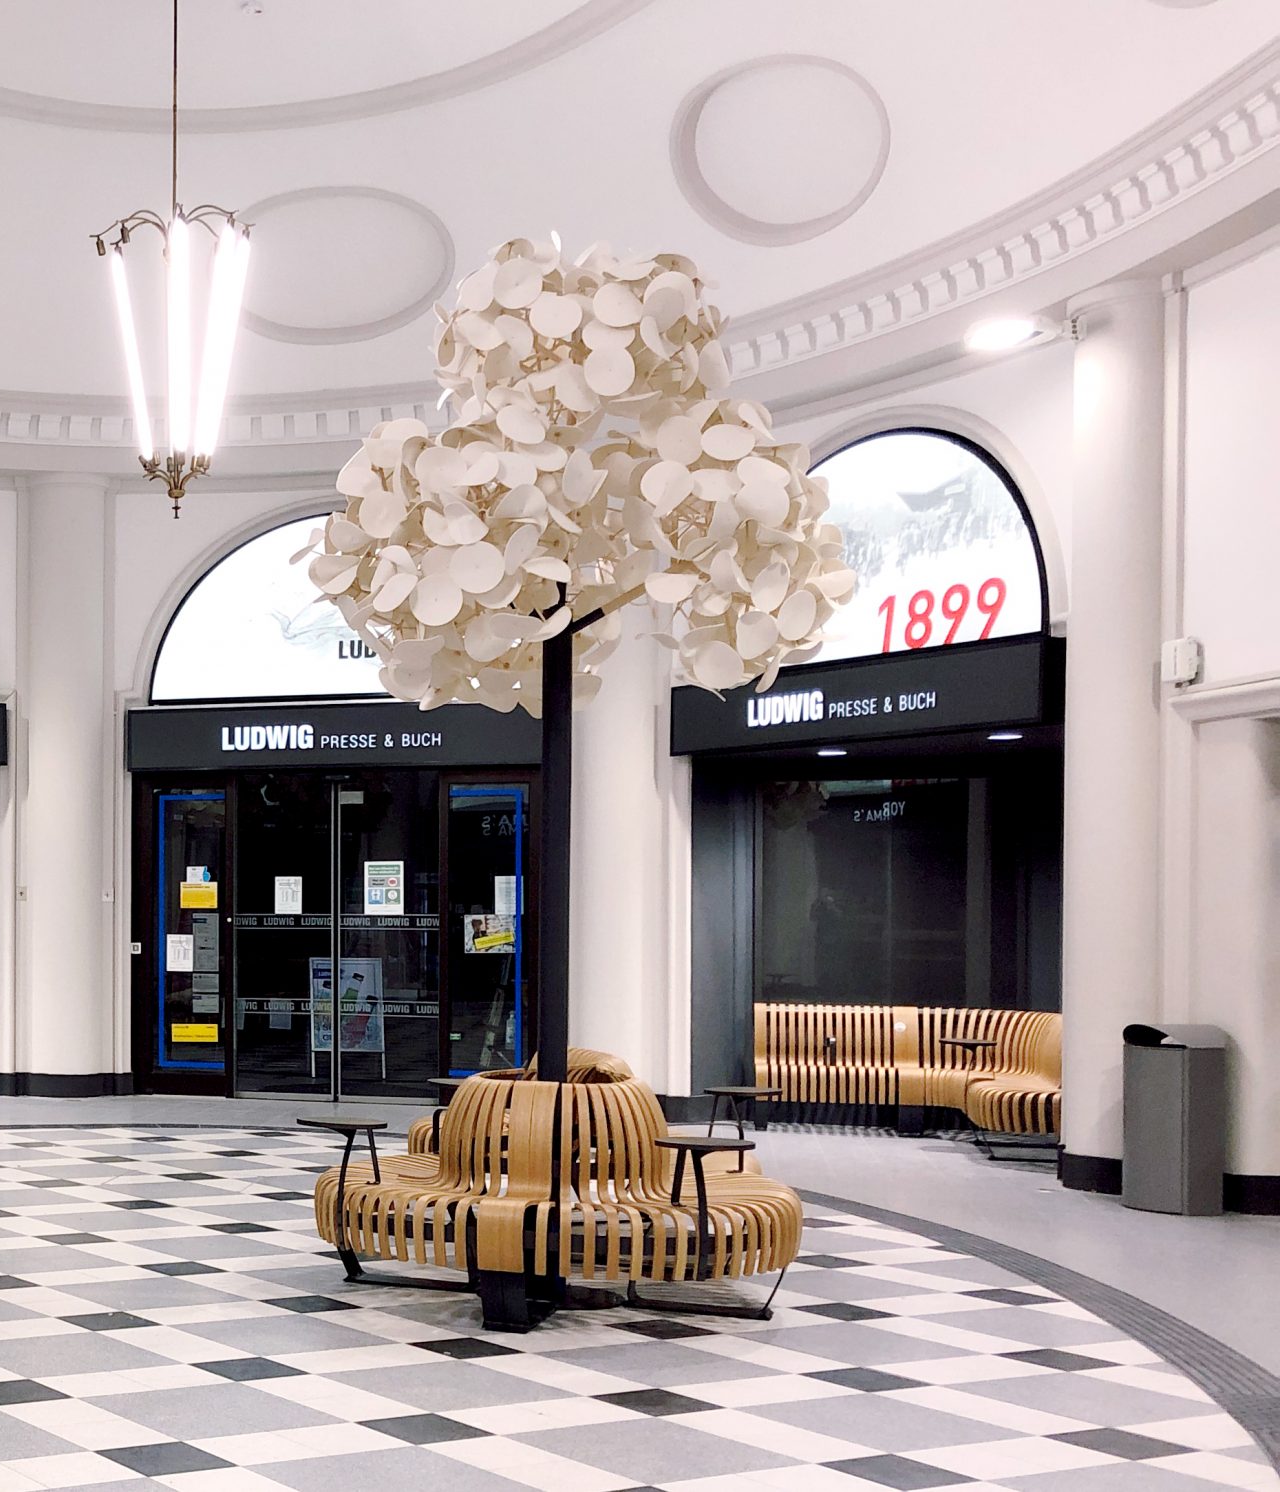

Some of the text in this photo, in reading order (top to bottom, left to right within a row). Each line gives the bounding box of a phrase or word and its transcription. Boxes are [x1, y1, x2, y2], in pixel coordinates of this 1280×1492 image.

[878, 577, 1007, 654] 1899
[338, 640, 377, 659] LUD
[747, 690, 936, 728] LUDWIG PRESSE & BUCH
[221, 724, 442, 752] LUDWIG PRESSE & BUCH
[263, 917, 295, 926] LUDWIG
[377, 917, 410, 927] LUDWIG
[416, 918, 440, 927] LUDW
[416, 1005, 440, 1014] LUDW
